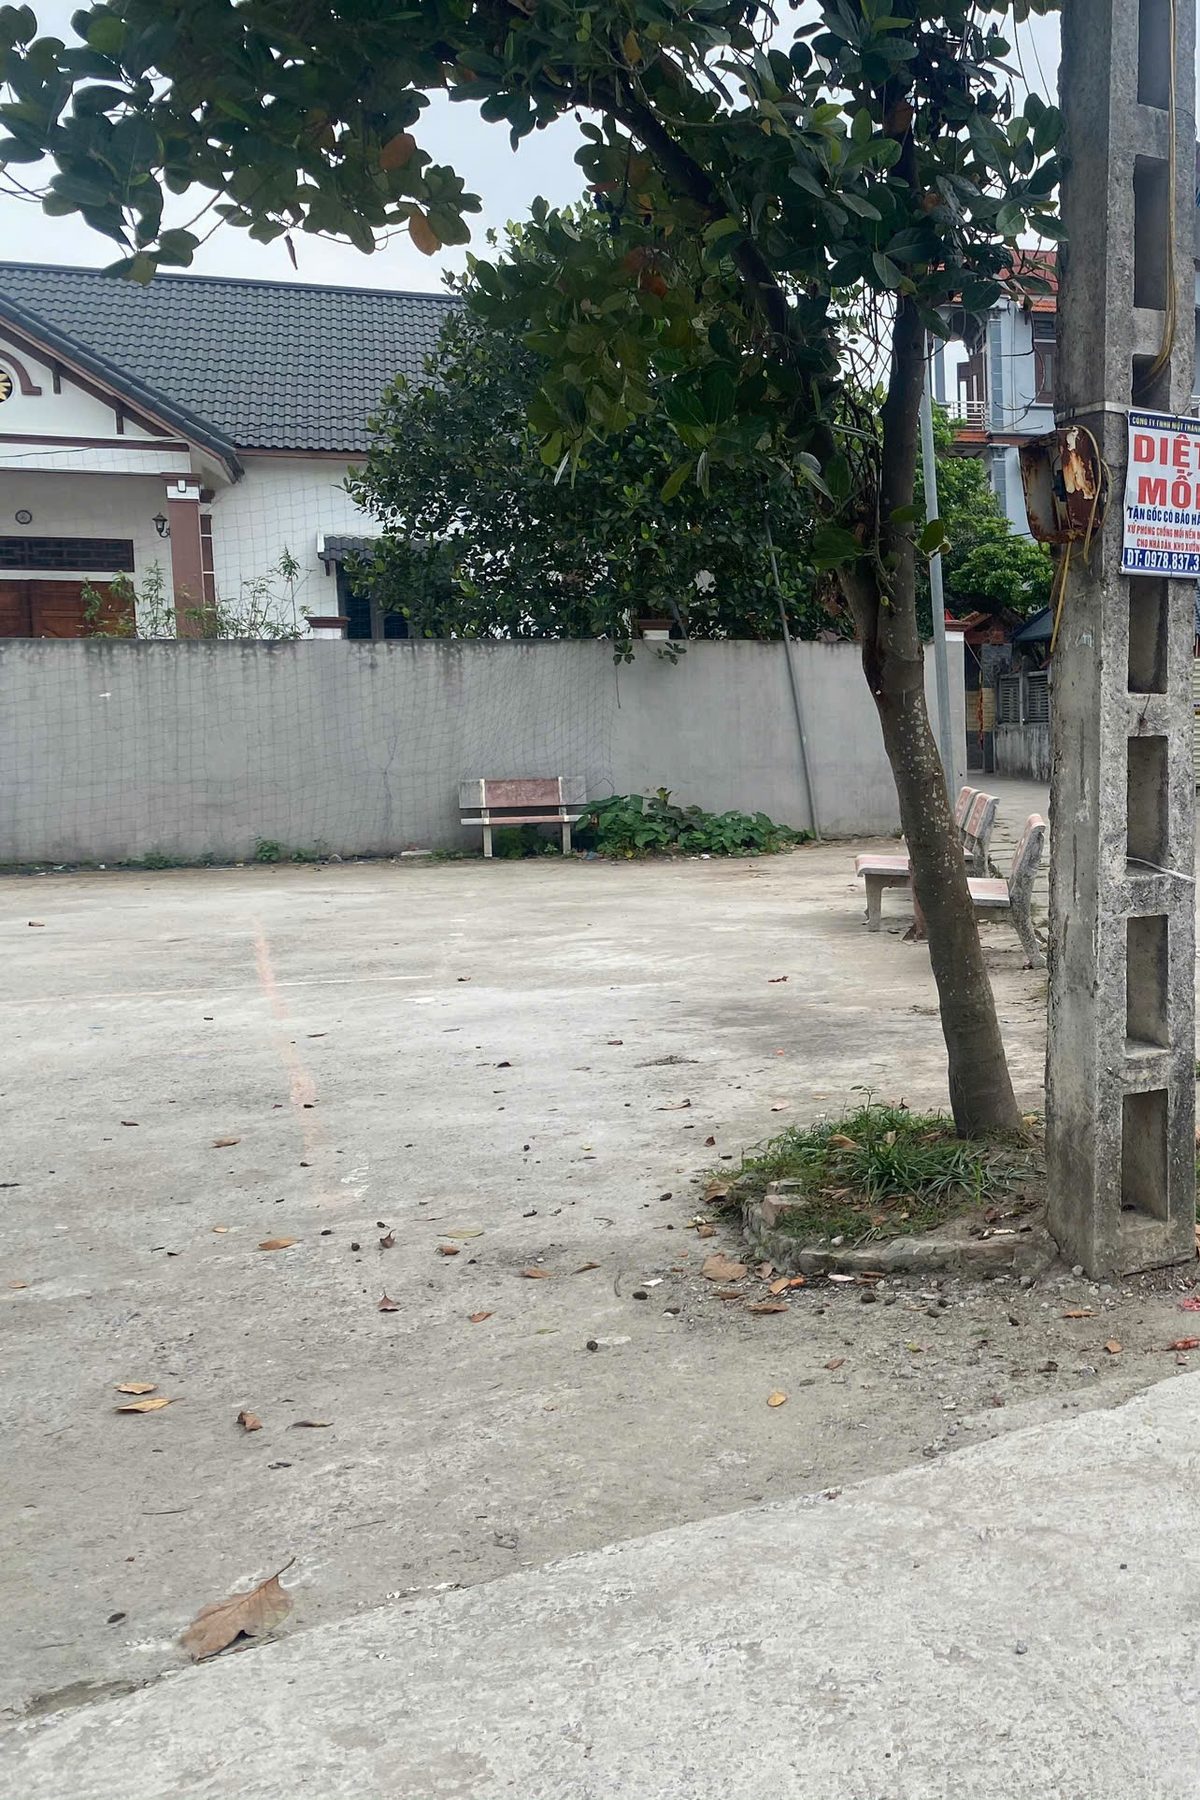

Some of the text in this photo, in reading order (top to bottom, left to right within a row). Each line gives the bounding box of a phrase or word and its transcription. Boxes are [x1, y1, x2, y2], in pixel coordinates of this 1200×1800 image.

[1127, 505, 1145, 522] TẬN
[1146, 505, 1162, 522] GỐC
[1163, 509, 1174, 523] CÓ
[1175, 508, 1190, 525] BẢO
